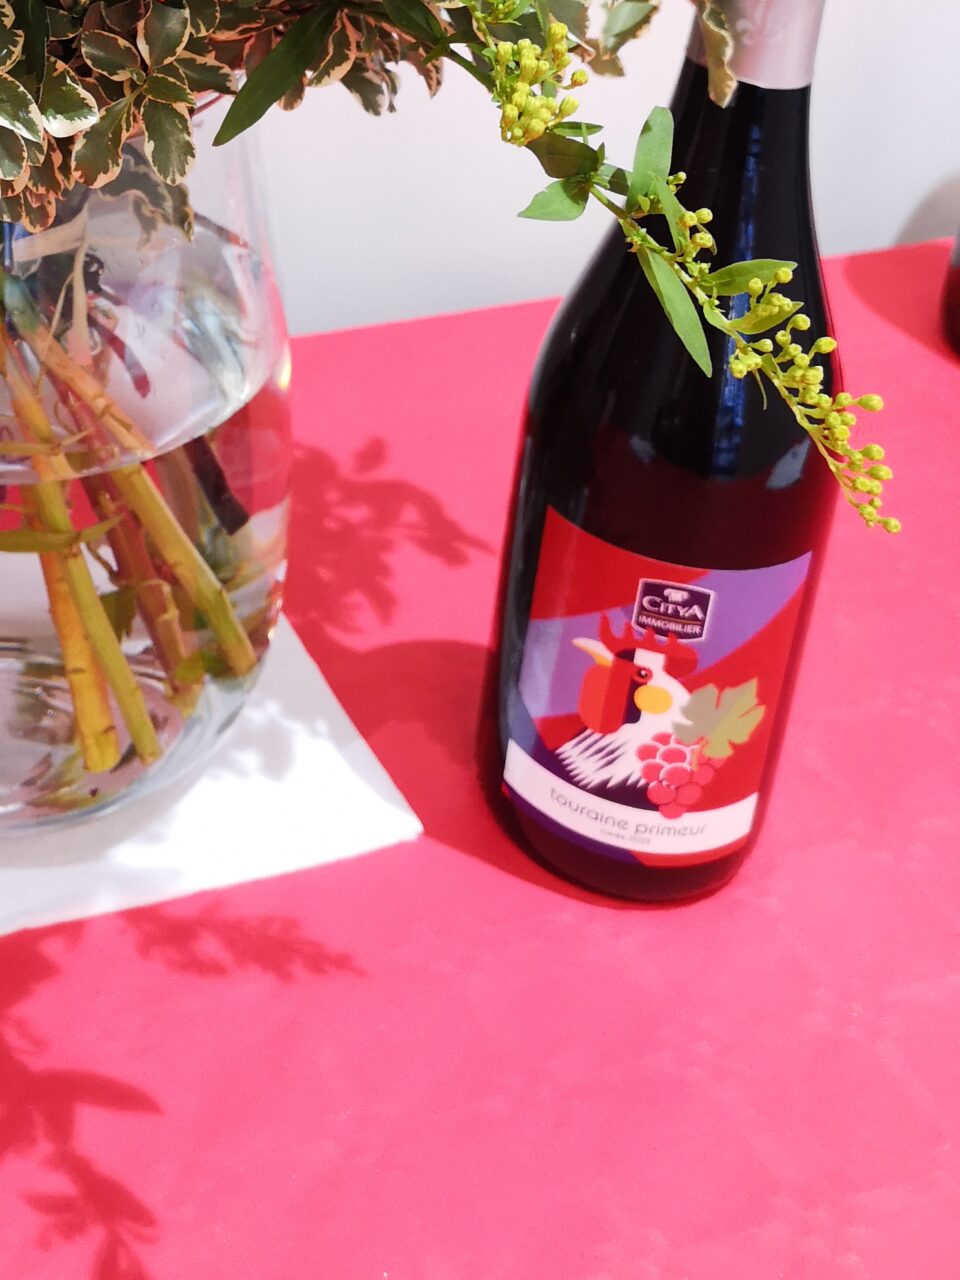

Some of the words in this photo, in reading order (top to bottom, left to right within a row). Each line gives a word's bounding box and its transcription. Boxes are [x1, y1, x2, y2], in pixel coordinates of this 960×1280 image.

[642, 595, 706, 621] CITYA
[638, 615, 703, 635] IMMOBILIER
[549, 786, 629, 831] touraine
[634, 822, 708, 837] primeur
